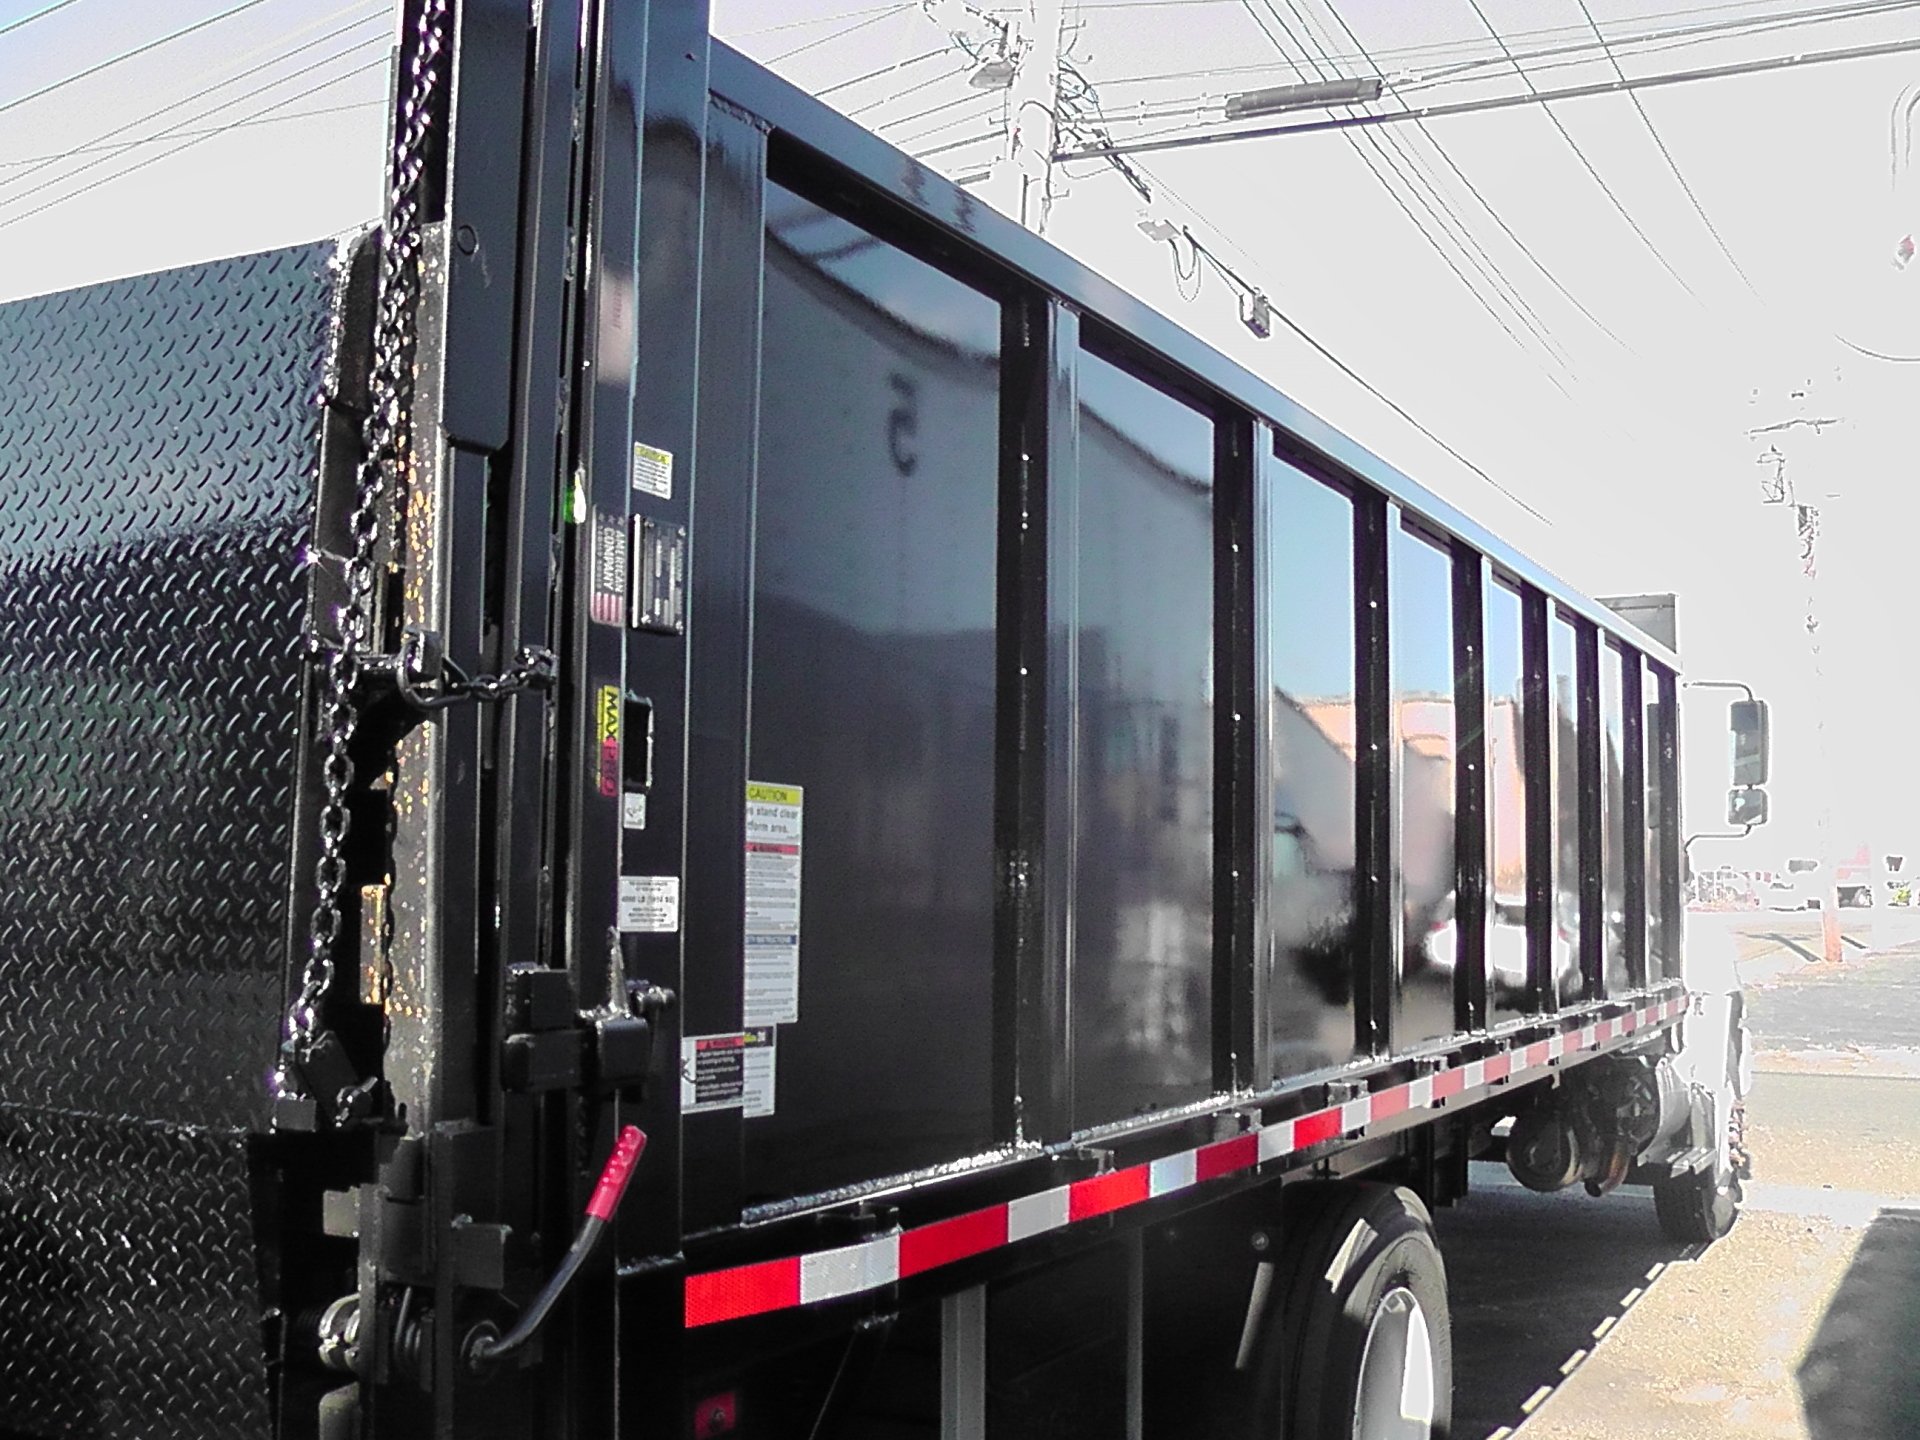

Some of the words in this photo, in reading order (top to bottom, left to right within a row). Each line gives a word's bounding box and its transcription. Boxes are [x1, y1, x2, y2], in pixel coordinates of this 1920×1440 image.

[603, 527, 615, 591] COMPANY
[614, 529, 625, 593] AMERICAN
[748, 785, 788, 802] CAUTION
